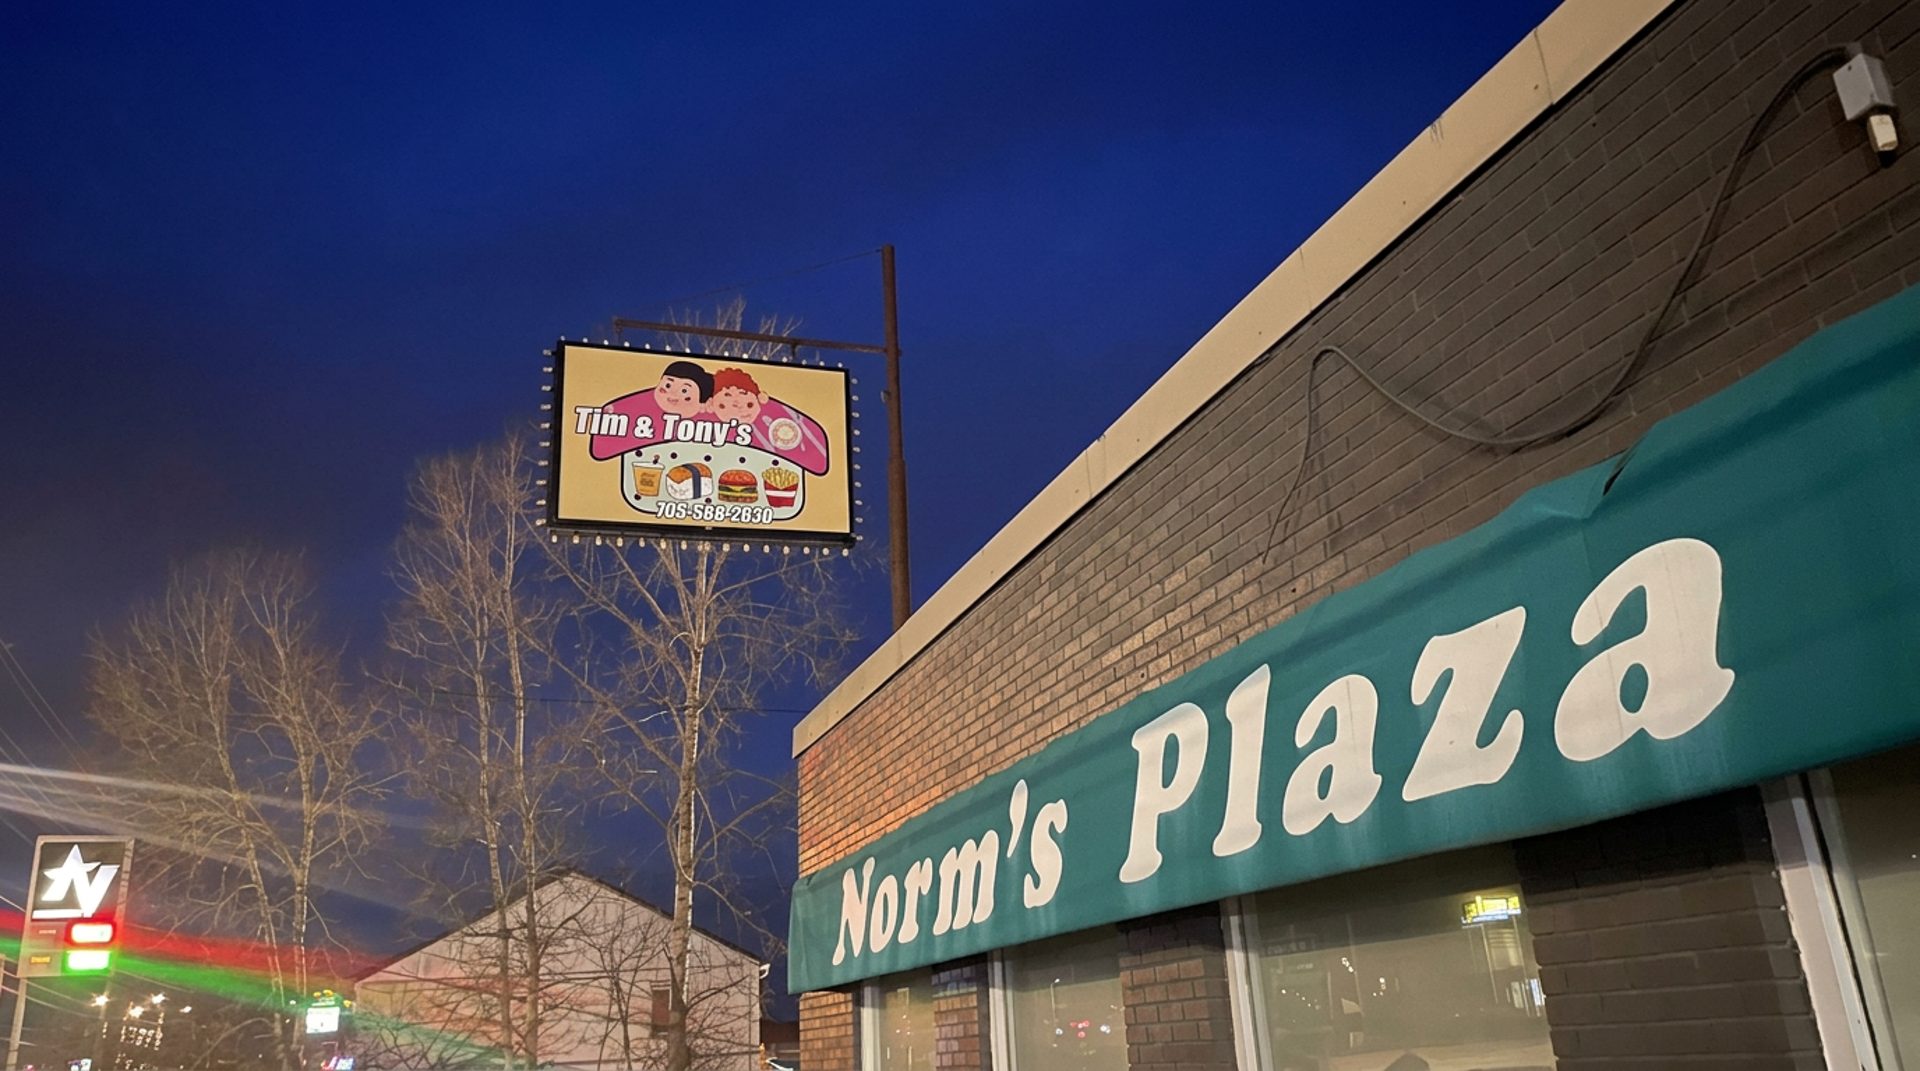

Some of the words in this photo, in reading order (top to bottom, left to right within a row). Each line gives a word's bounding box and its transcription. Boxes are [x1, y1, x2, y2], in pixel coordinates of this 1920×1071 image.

[575, 406, 629, 437] Tim
[634, 415, 655, 438] &
[663, 413, 752, 446] Tony's
[832, 780, 1067, 965] Norm's
[1120, 537, 1735, 883] Plaza
